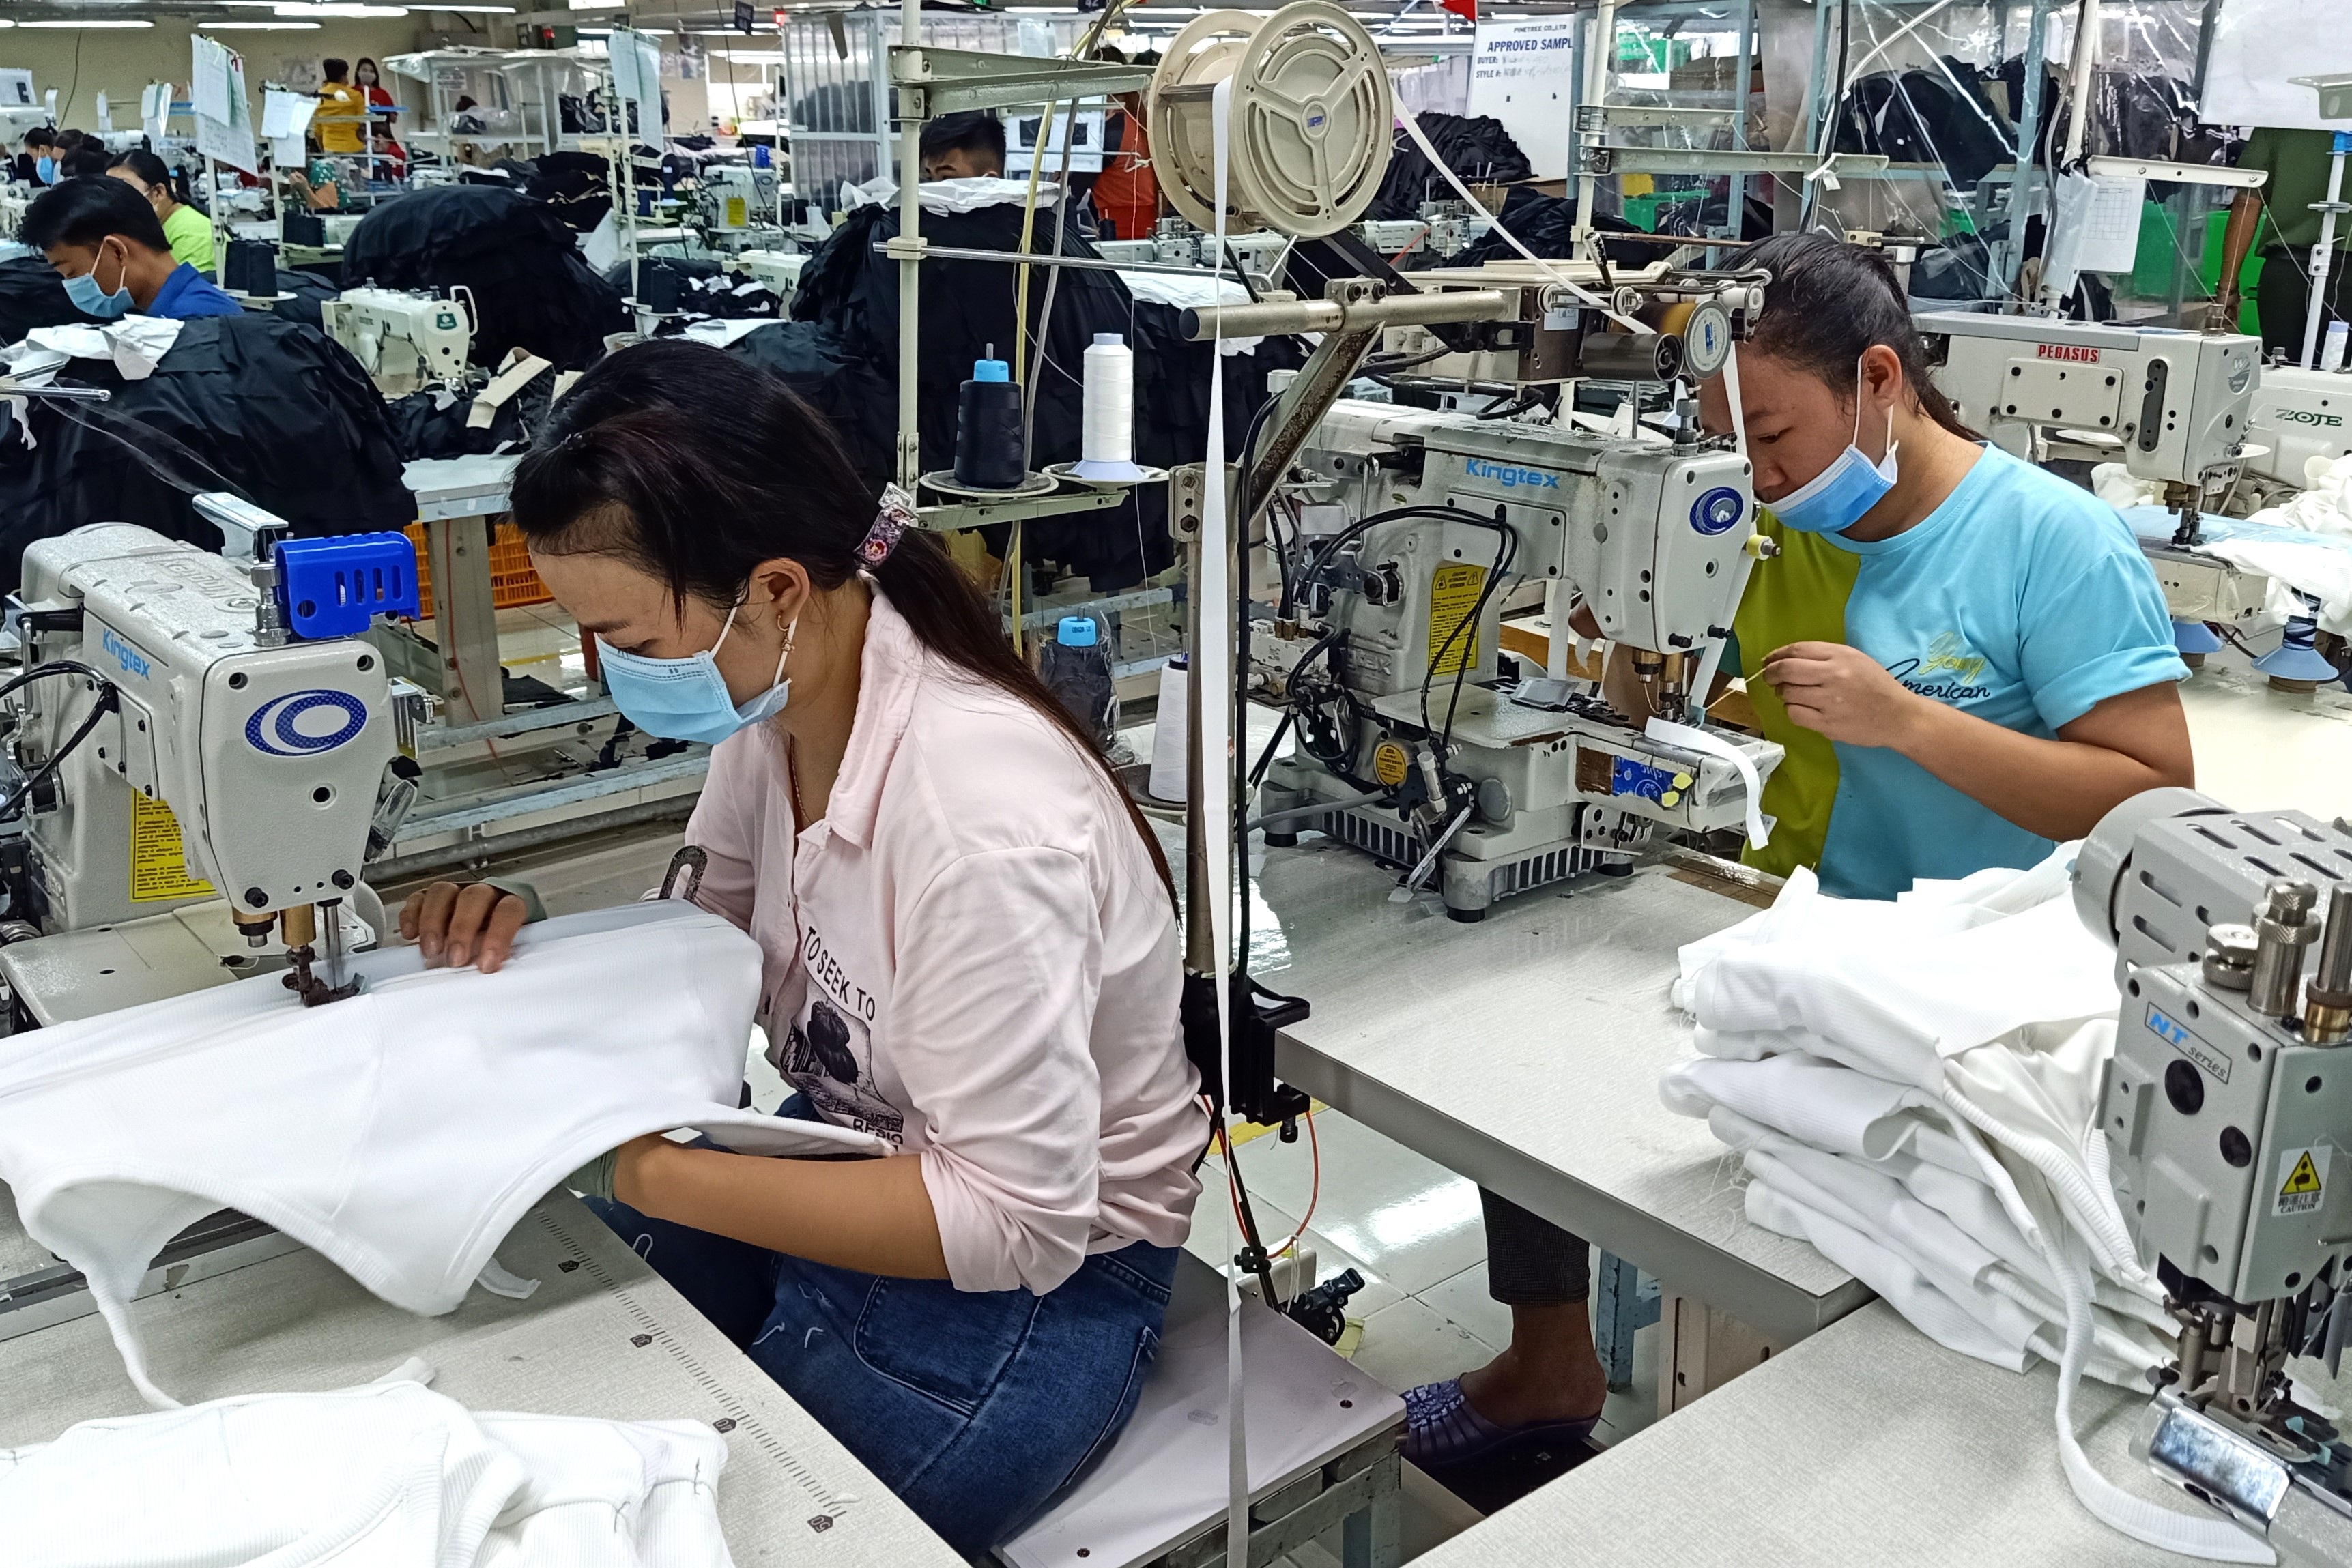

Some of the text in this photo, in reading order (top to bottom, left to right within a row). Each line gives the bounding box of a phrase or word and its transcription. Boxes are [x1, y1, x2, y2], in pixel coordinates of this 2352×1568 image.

[1513, 25, 1543, 33] PINETREE
[1487, 39, 1538, 53] APPROVED
[1477, 56, 1499, 65] BUYER:
[1476, 70, 1494, 78] STYLE
[2038, 345, 2099, 362] PEGASUS
[2275, 408, 2343, 427] ZOJE
[1465, 458, 1560, 489] Kingtex
[103, 628, 151, 681] Kingtex
[1919, 631, 1986, 684] Young
[803, 925, 876, 1021] TO SEEK TO
[2149, 1012, 2227, 1077] NT series
[2280, 1202, 2316, 1214] CAUTION
[633, 1335, 650, 1346] 30
[715, 1419, 733, 1432] 40
[811, 1516, 831, 1533] 50
